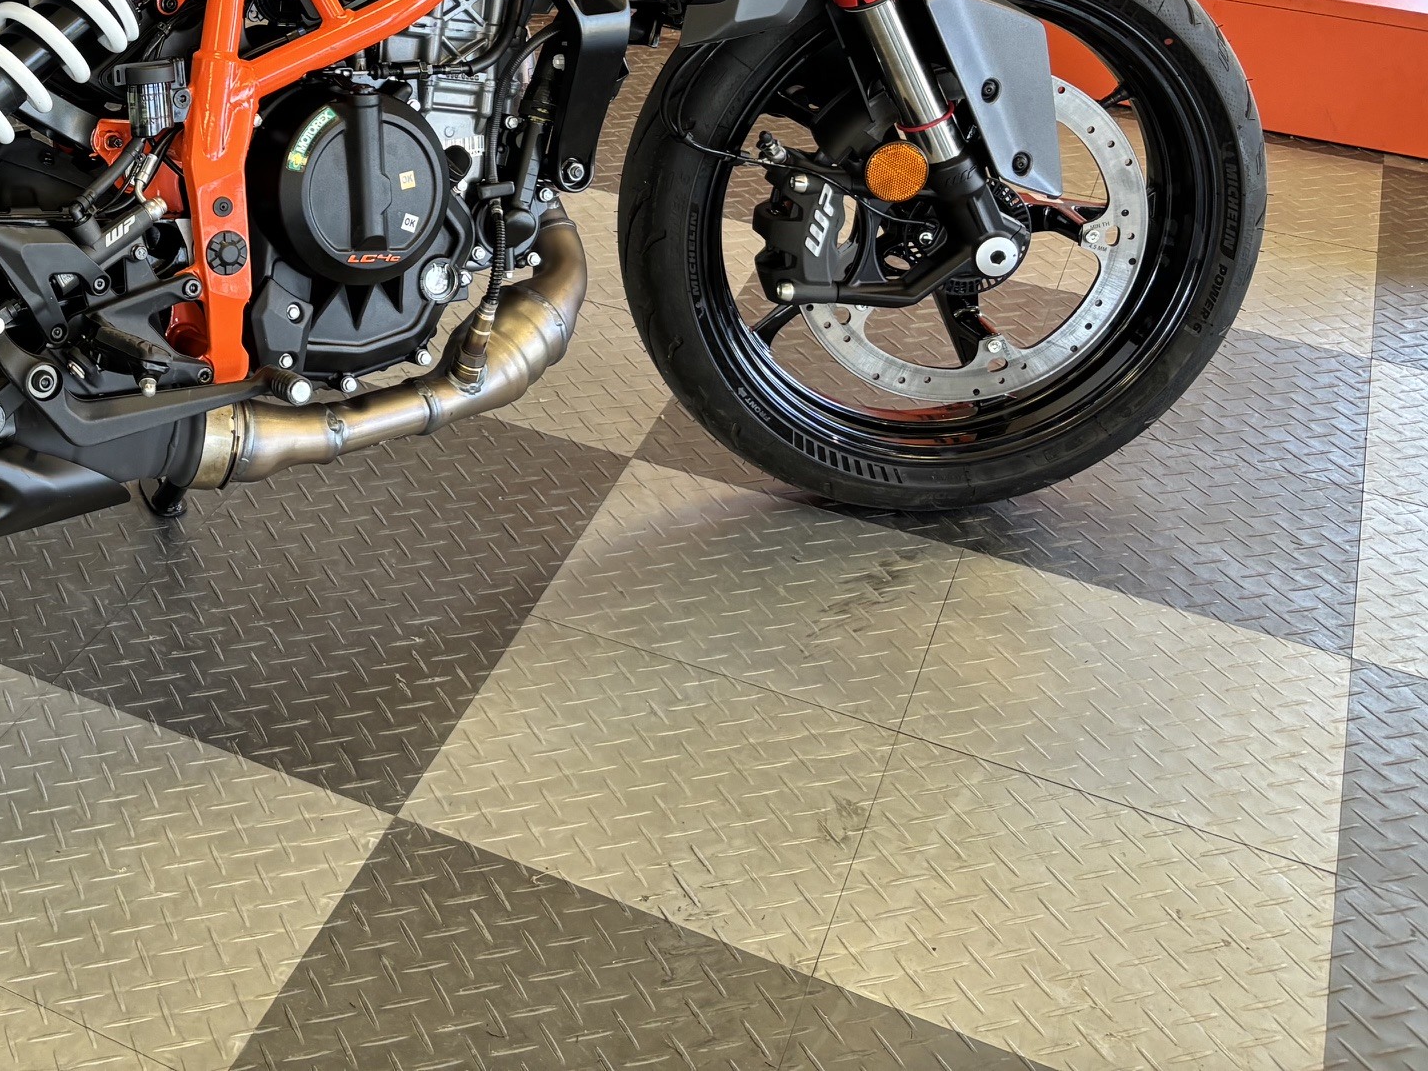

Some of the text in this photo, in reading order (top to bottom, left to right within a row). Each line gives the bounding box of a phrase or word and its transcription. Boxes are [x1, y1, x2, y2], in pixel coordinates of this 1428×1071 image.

[295, 109, 332, 154] MOTOREX
[401, 174, 414, 184] OK
[404, 217, 416, 227] OK
[805, 183, 834, 257] WP
[1222, 162, 1240, 254] MICHELIN
[105, 215, 136, 248] WP
[688, 211, 701, 296] MICHELIN
[1198, 262, 1228, 320] POWER
[744, 397, 771, 422] FRONT
